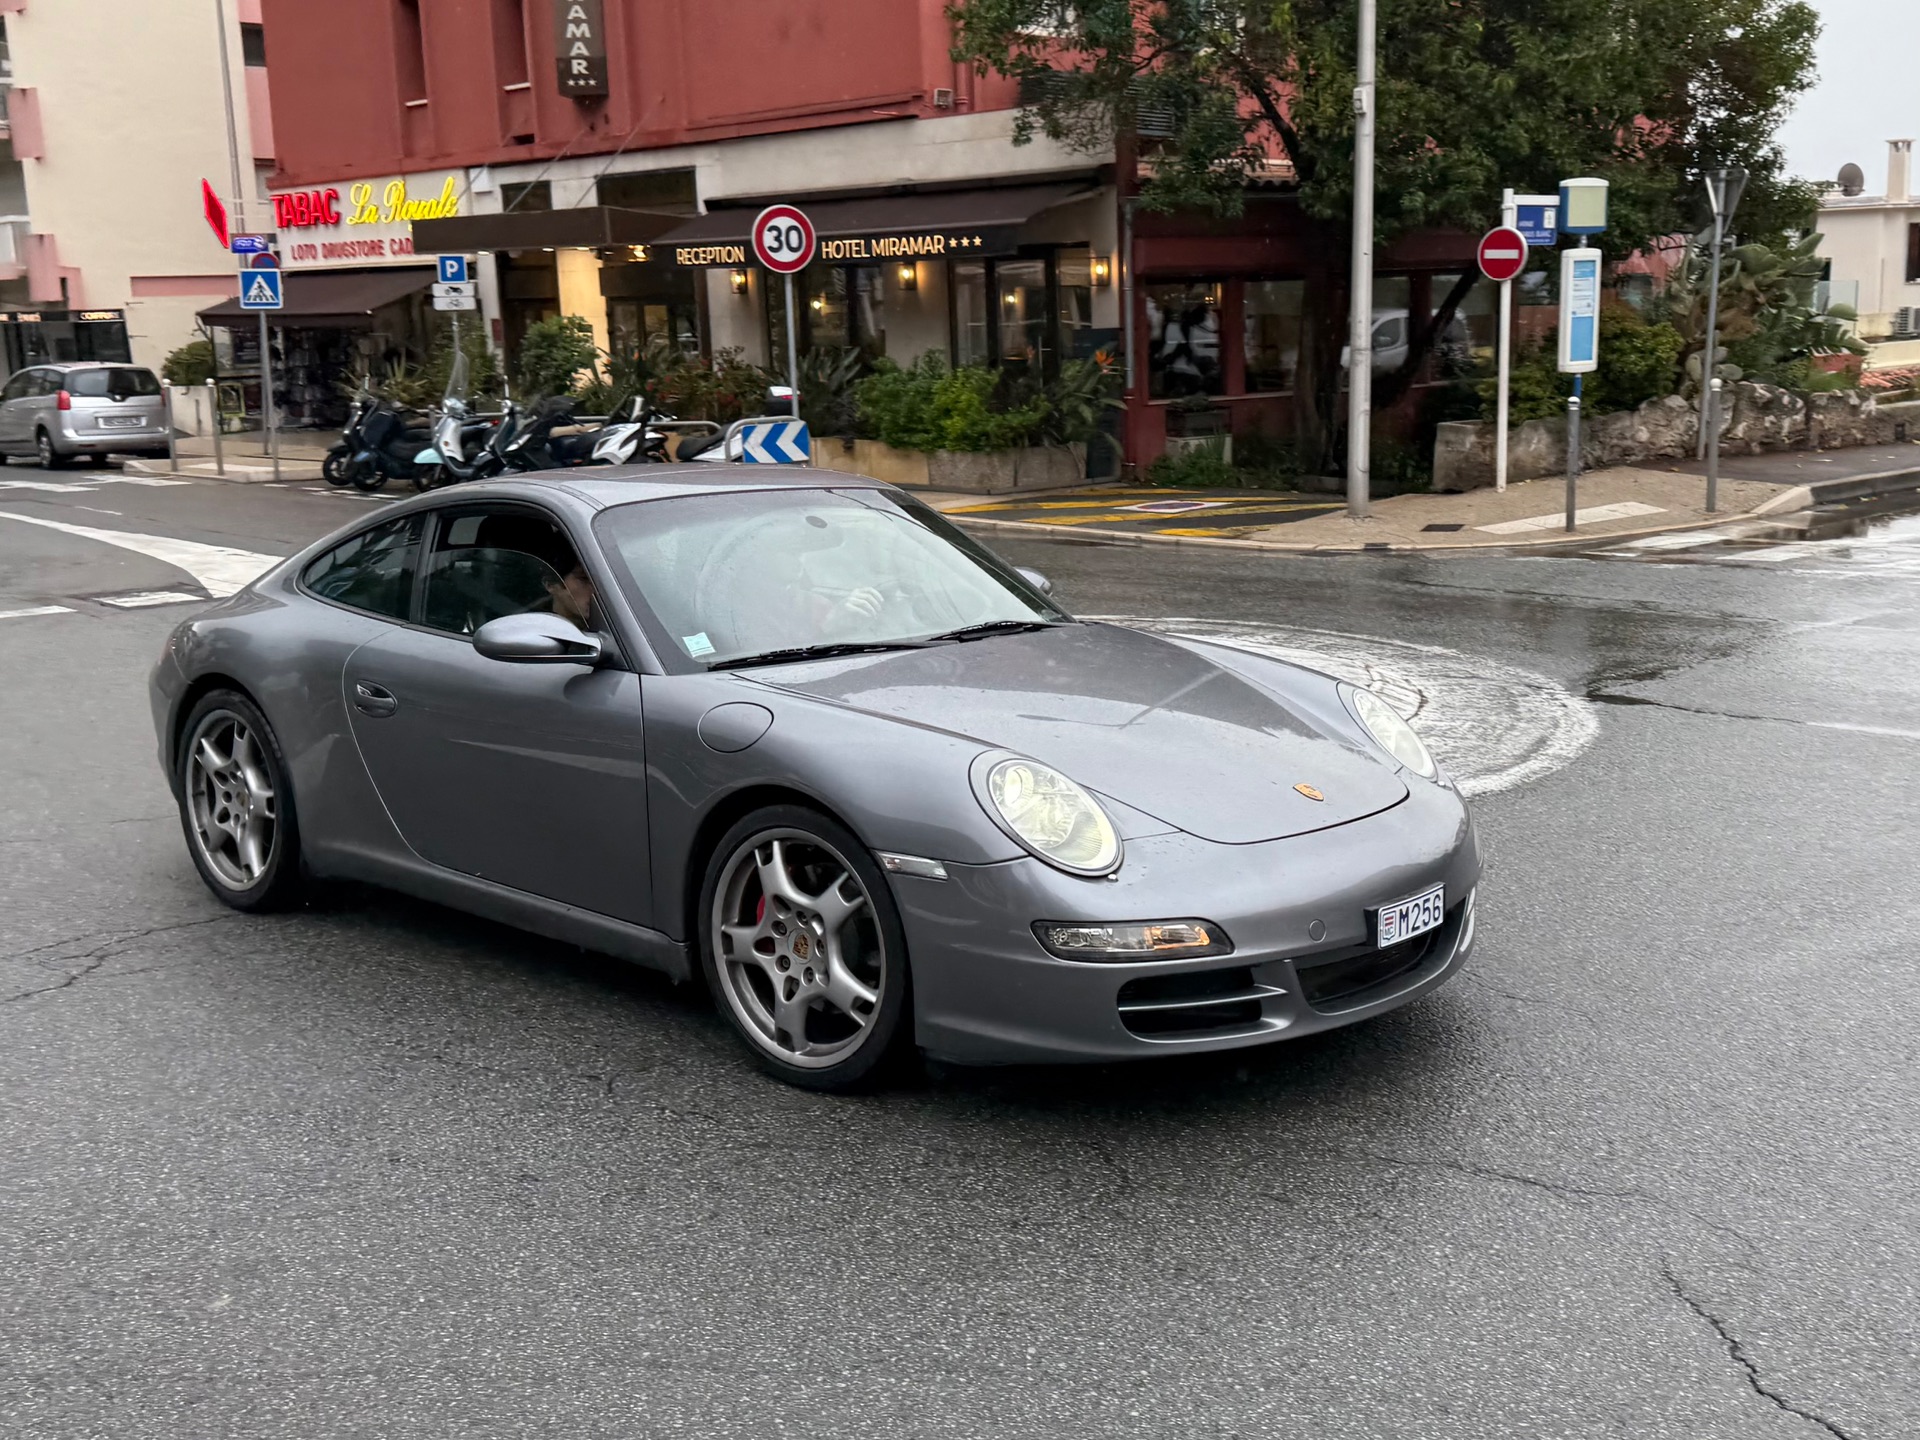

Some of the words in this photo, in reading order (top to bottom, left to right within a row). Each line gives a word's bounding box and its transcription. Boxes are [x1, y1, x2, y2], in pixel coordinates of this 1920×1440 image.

[566, 0, 591, 75] AMAR
[270, 188, 341, 228] TABAC
[346, 183, 378, 225] La
[291, 243, 318, 261] LOTO
[321, 239, 385, 259] DRUGSTORE
[676, 246, 745, 265] RECEPTION
[821, 239, 870, 259] HOTEL
[871, 235, 945, 257] MIRAMAR
[767, 225, 805, 253] 30
[445, 260, 459, 278] P
[1399, 894, 1441, 937] M256
